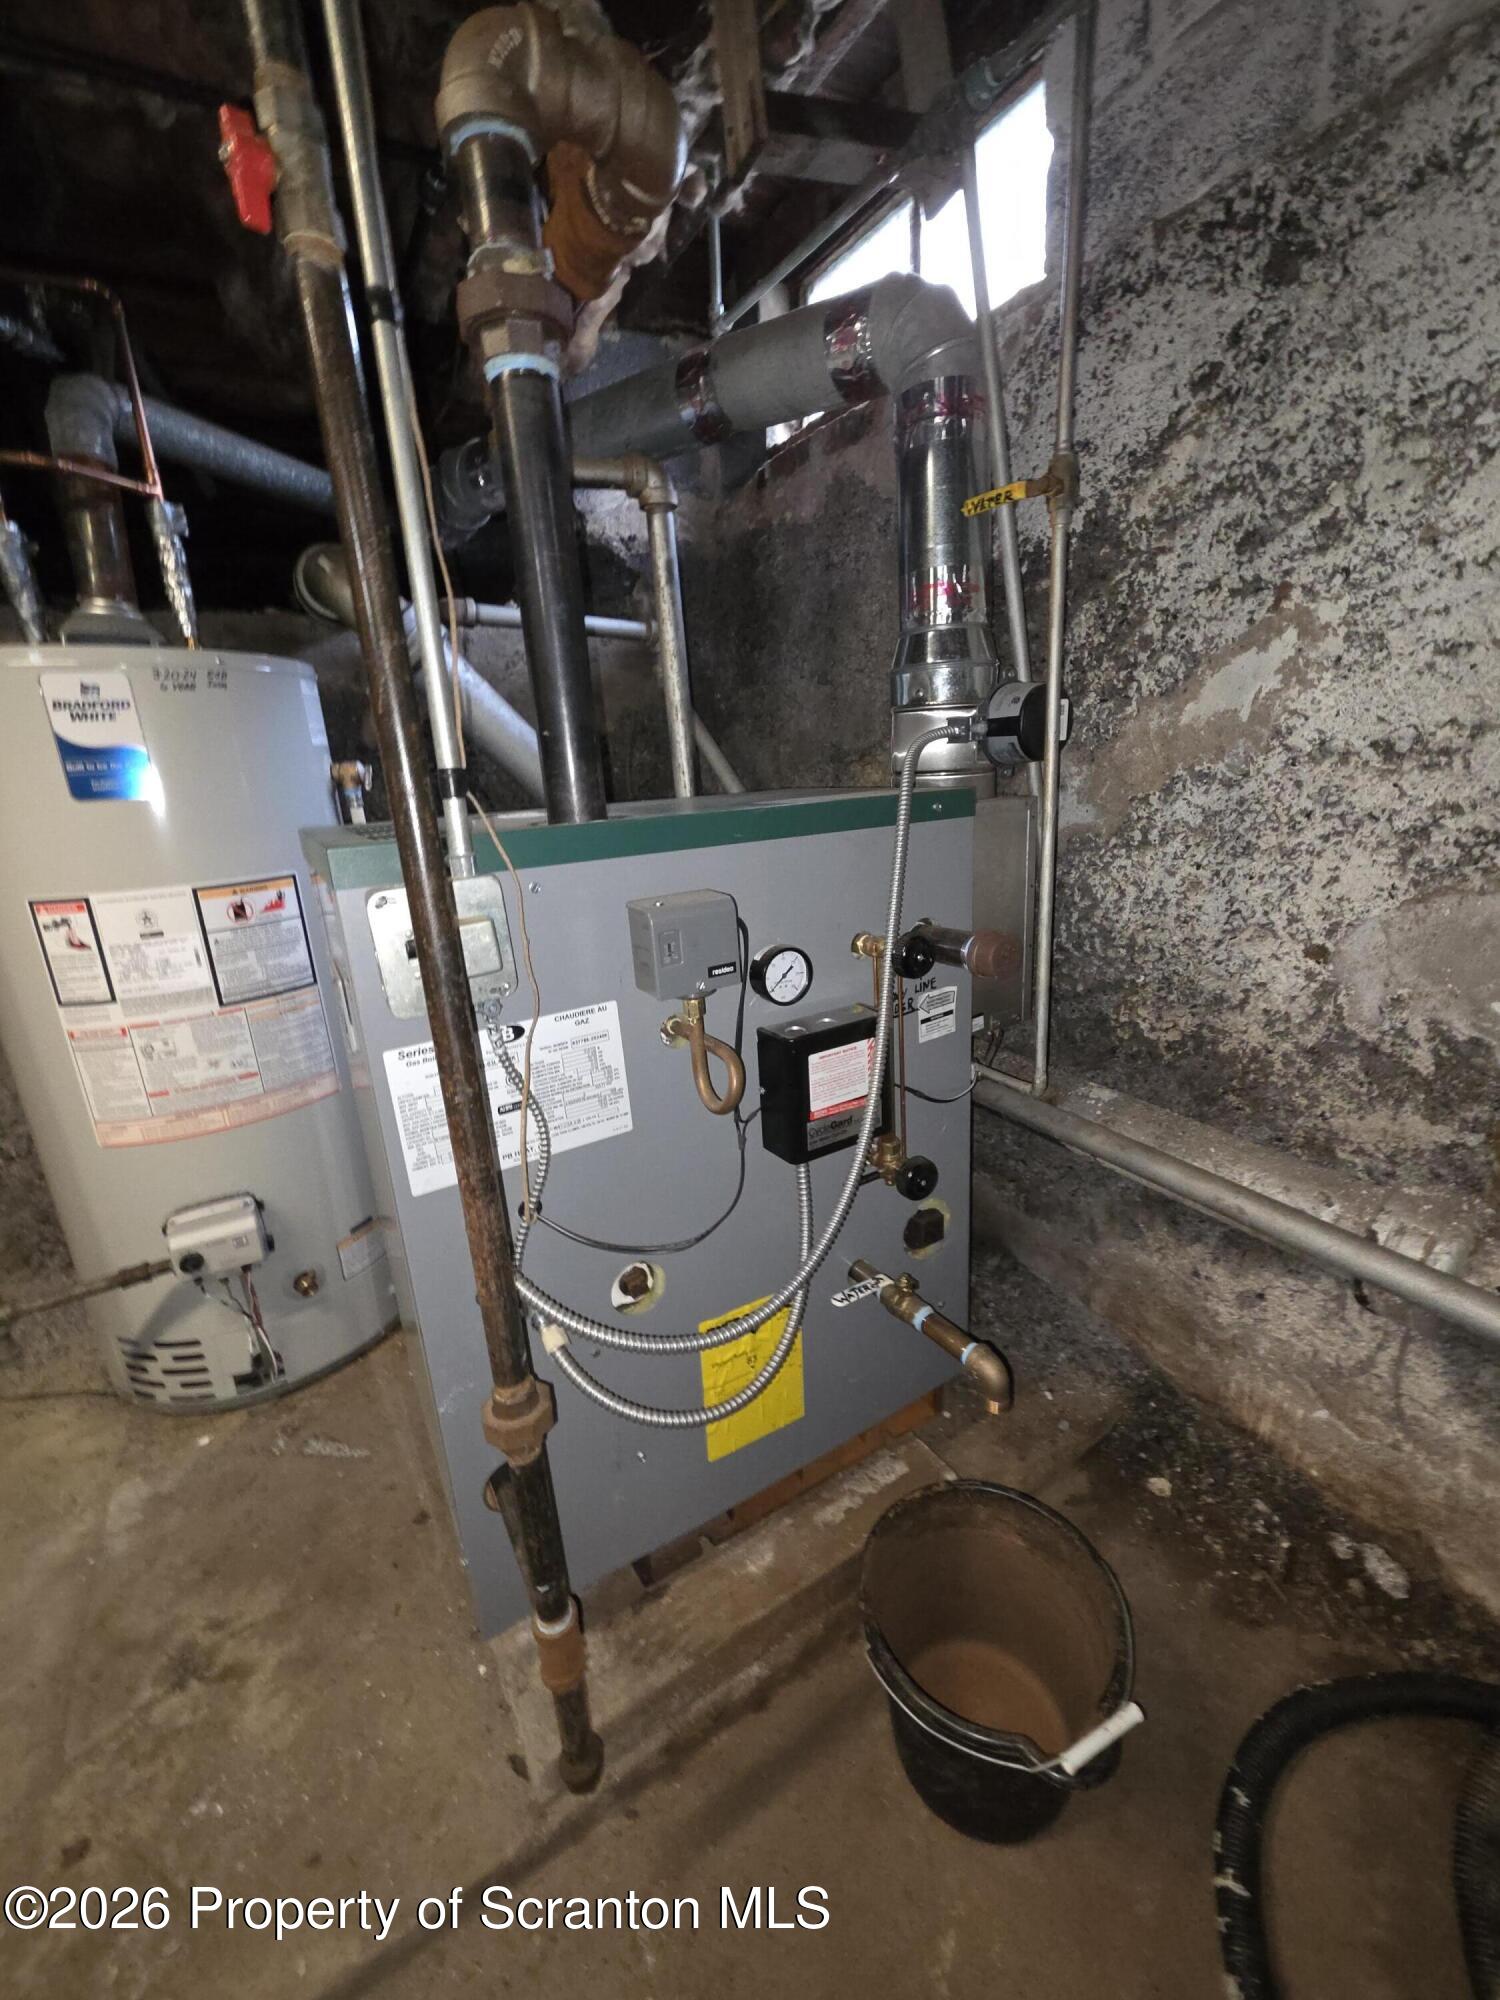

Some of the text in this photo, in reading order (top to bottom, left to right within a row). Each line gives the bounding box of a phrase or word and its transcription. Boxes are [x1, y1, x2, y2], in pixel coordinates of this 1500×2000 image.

[52, 700, 131, 712] BRADFORD
[69, 711, 117, 723] WHITE
[712, 965, 734, 976] resideo
[915, 977, 937, 993] LINE
[554, 1005, 608, 1022] CHAUDIERE AU
[574, 1017, 590, 1026] GAZ
[398, 1045, 436, 1061] Series
[406, 1059, 421, 1067] Gas
